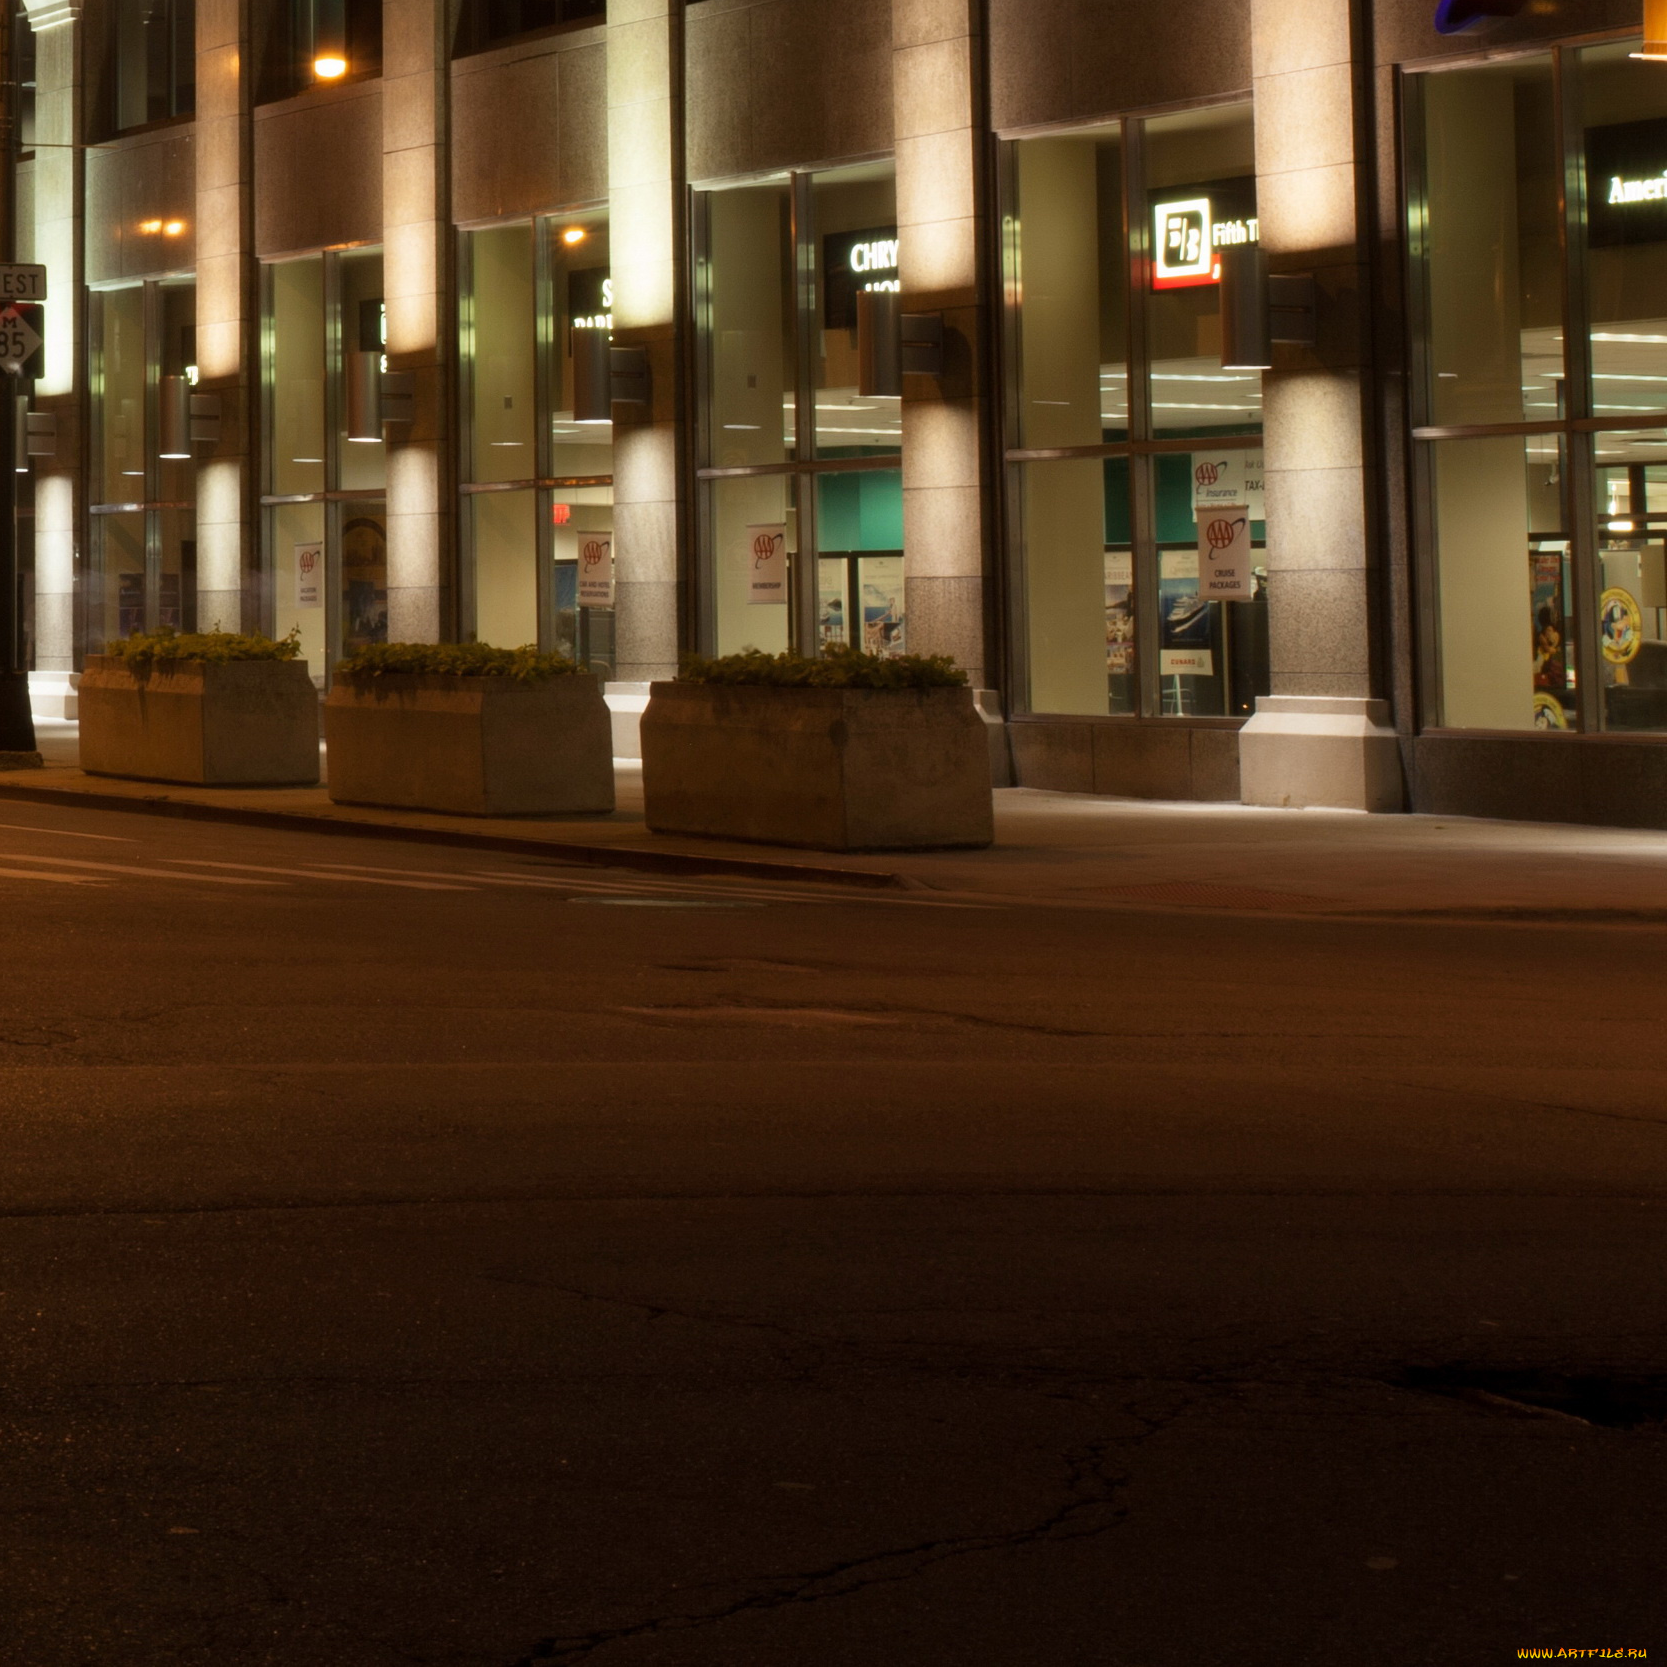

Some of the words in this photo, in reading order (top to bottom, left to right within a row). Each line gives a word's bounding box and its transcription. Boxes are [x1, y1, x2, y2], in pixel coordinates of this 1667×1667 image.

[1212, 220, 1247, 246] Fifth
[2, 316, 17, 329] M
[1206, 488, 1238, 498] Insurance
[1207, 519, 1234, 549] AAA
[1214, 568, 1235, 578] CRUISE
[1209, 580, 1241, 589] PACKAGES
[1170, 658, 1196, 666] CUNARD
